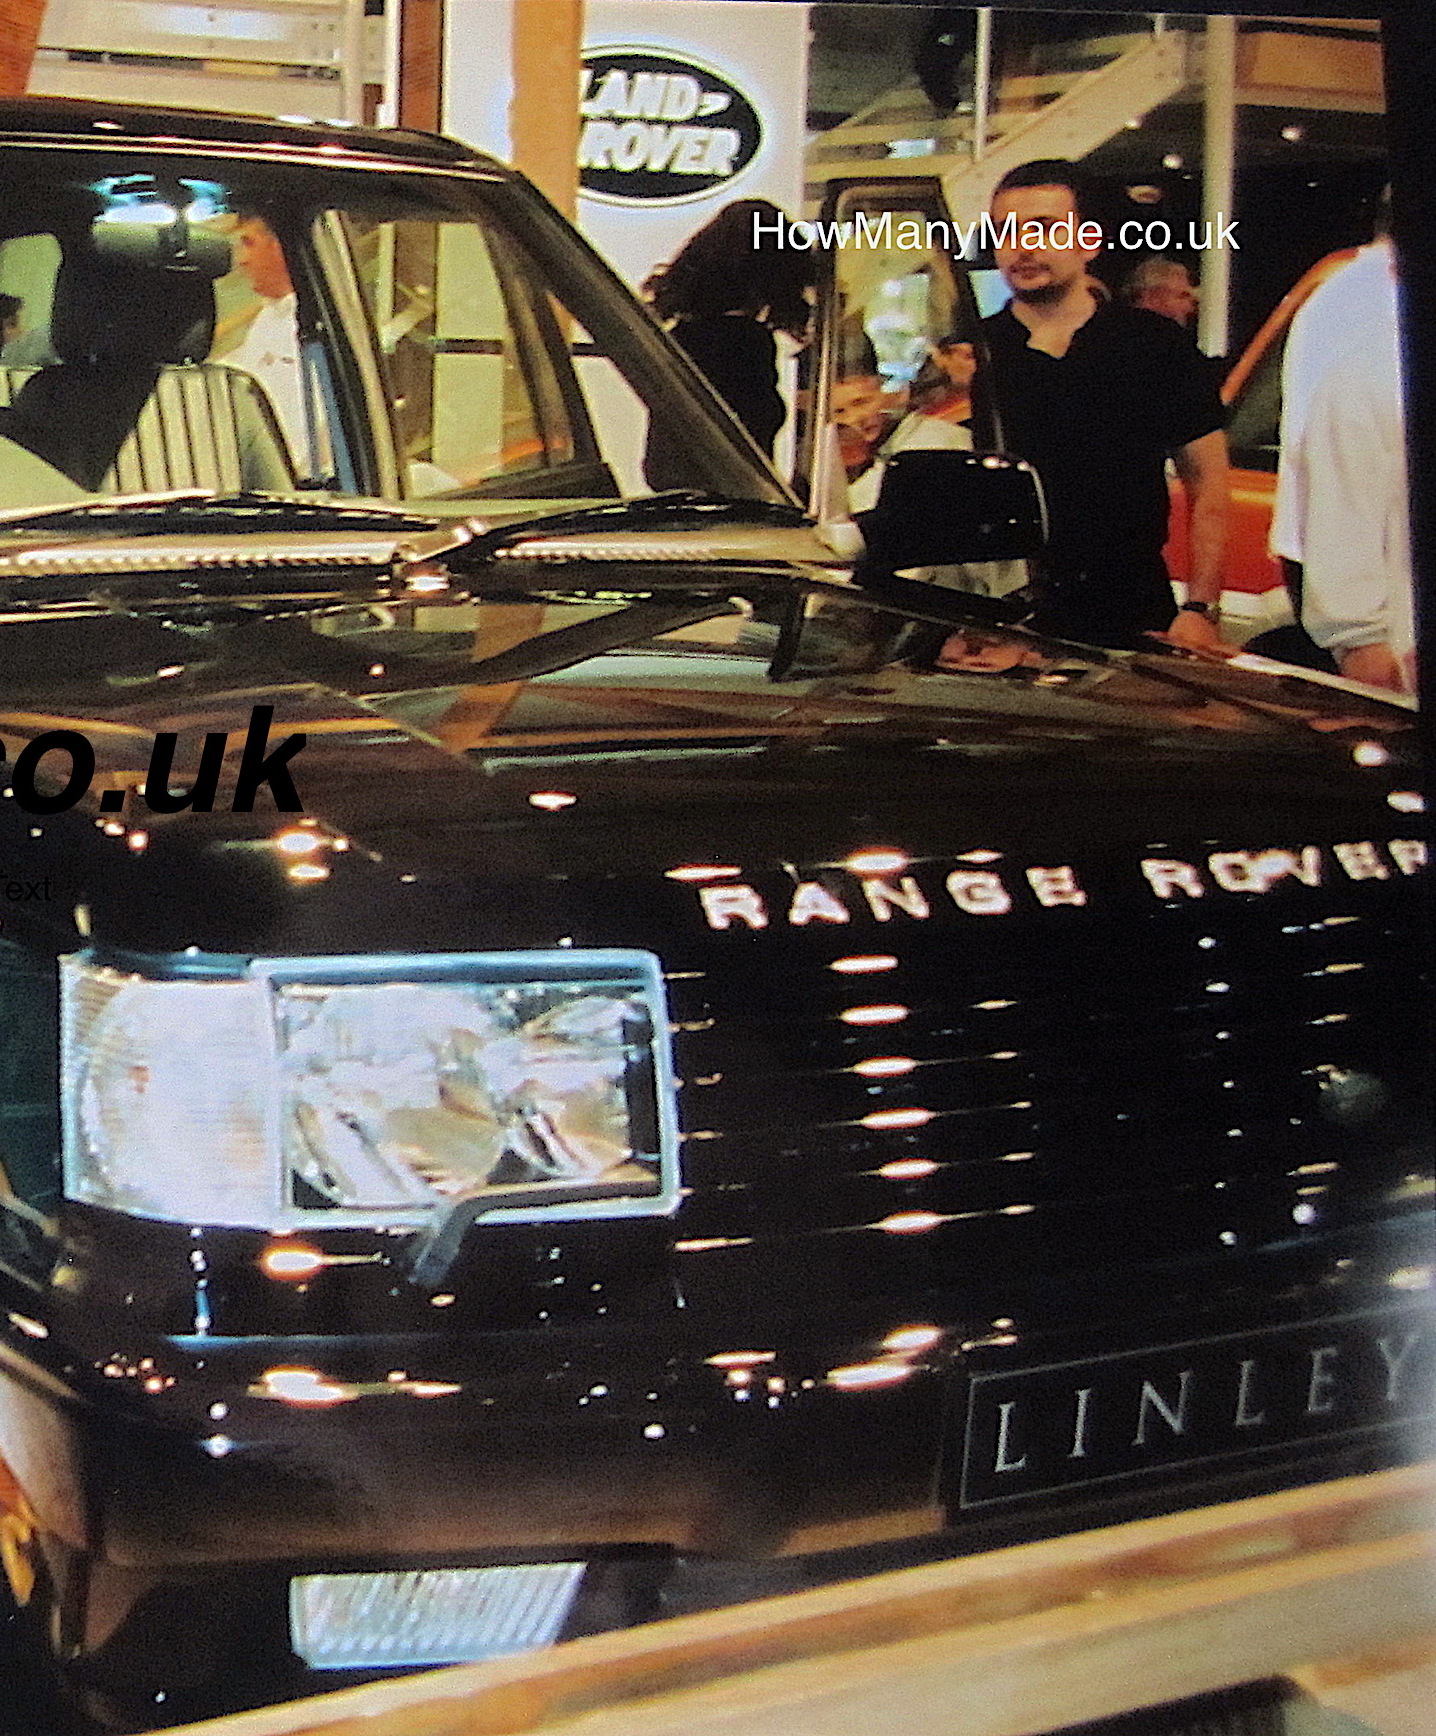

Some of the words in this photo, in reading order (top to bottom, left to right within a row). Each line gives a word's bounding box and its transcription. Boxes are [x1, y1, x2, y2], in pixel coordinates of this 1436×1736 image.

[577, 120, 742, 176] ROVER
[699, 864, 1087, 930] RANGE
[1140, 838, 1428, 898] ROVER
[994, 1333, 1420, 1473] LINLEY
